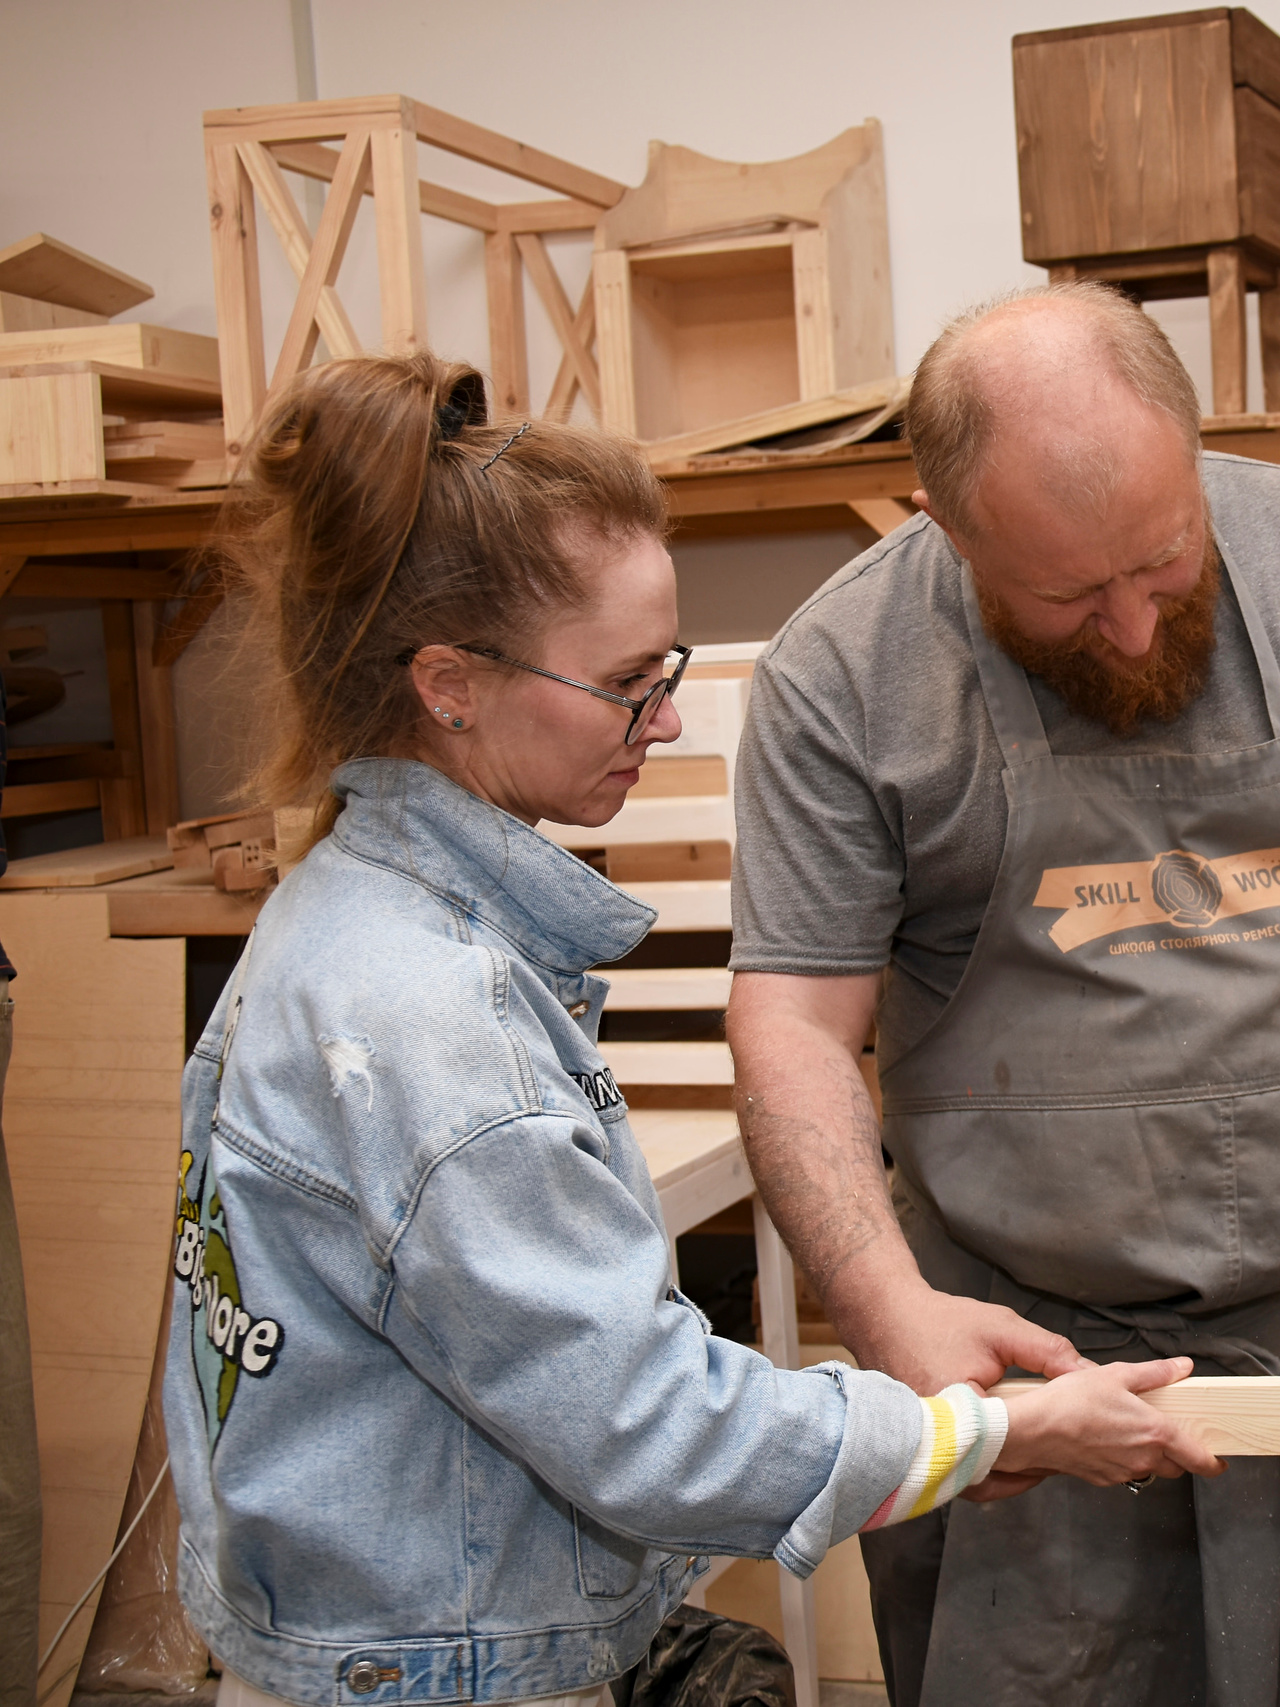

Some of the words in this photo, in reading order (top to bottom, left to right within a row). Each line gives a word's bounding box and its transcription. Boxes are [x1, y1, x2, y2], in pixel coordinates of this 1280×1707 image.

[1074, 881, 1140, 908] SKILL
[1109, 940, 1156, 956] ШКОЛА
[1160, 933, 1240, 950] СТОЛЯРНОГО
